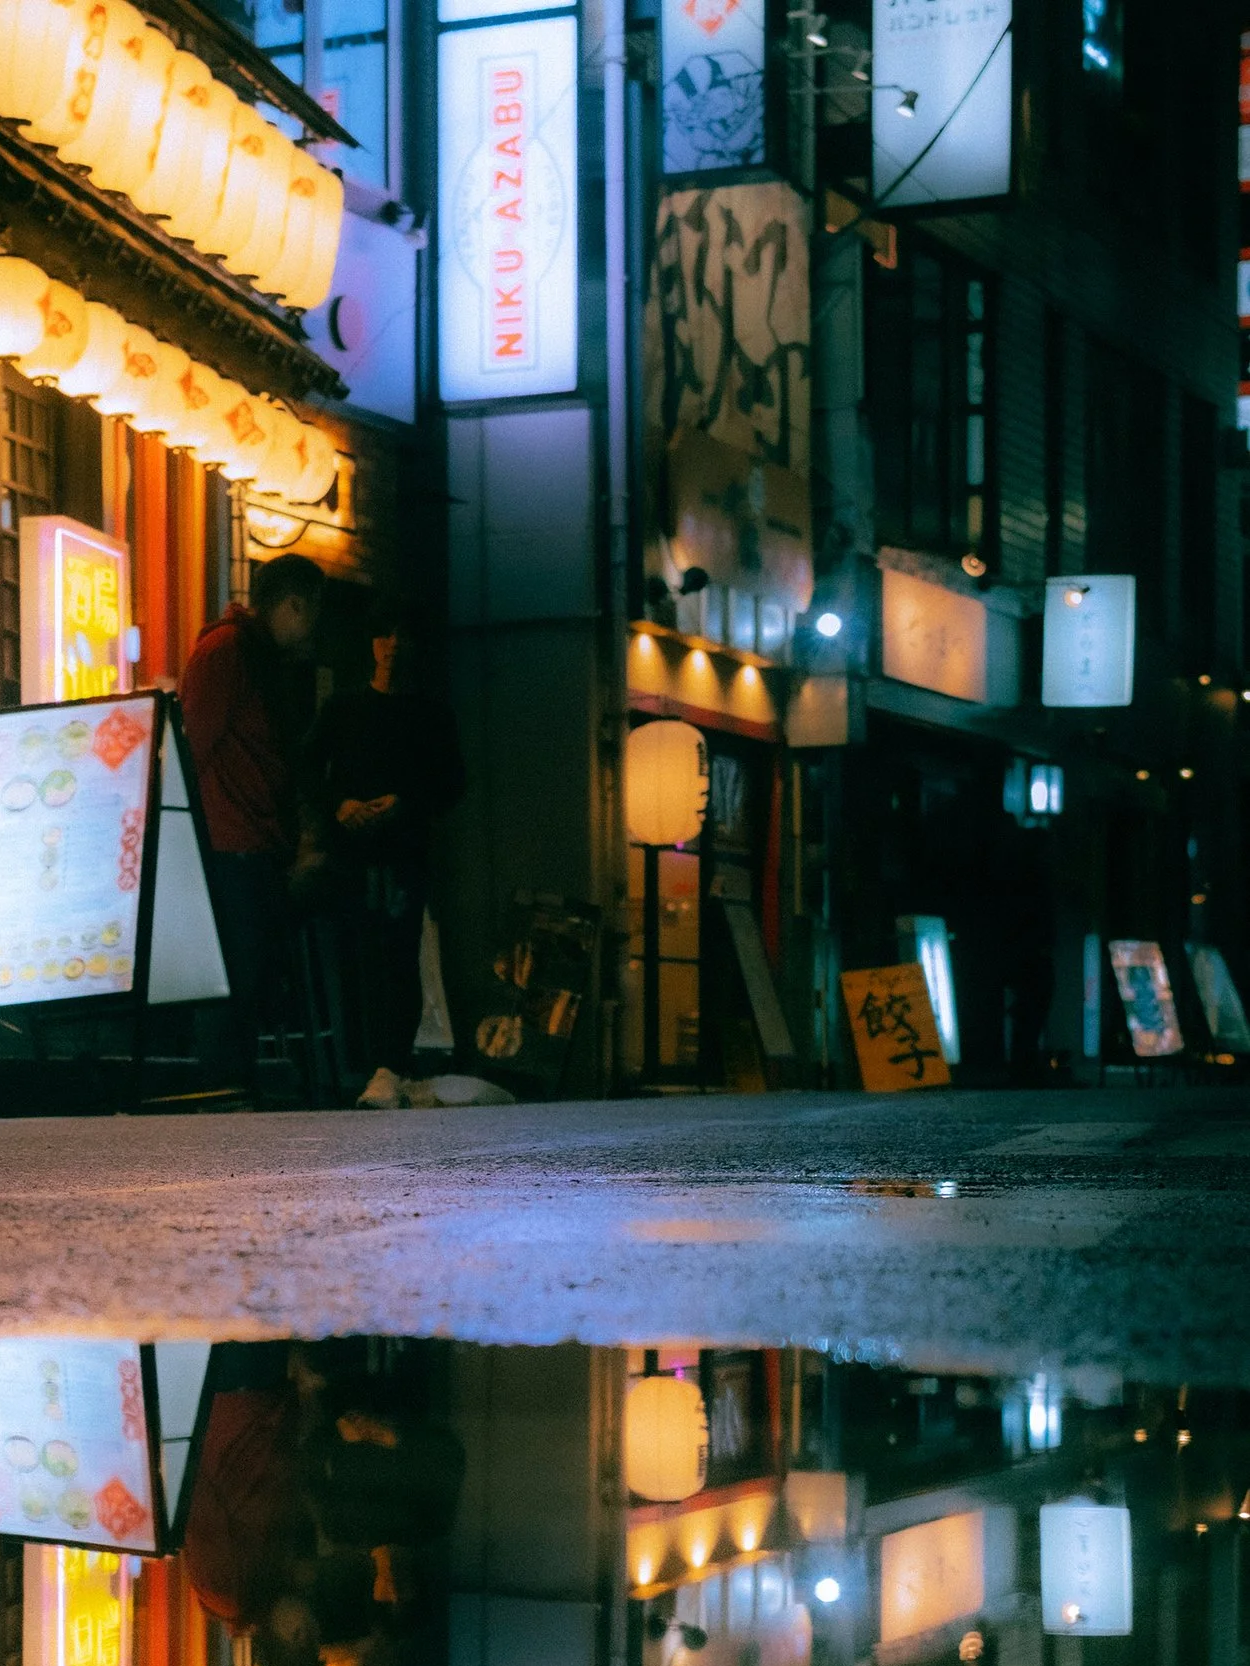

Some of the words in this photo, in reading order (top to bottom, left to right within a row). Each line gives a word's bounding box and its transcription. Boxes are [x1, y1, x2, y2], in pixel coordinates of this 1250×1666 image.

[493, 68, 525, 224] AZABU
[493, 256, 525, 360] NIKU
[857, 991, 940, 1081] 餃子
